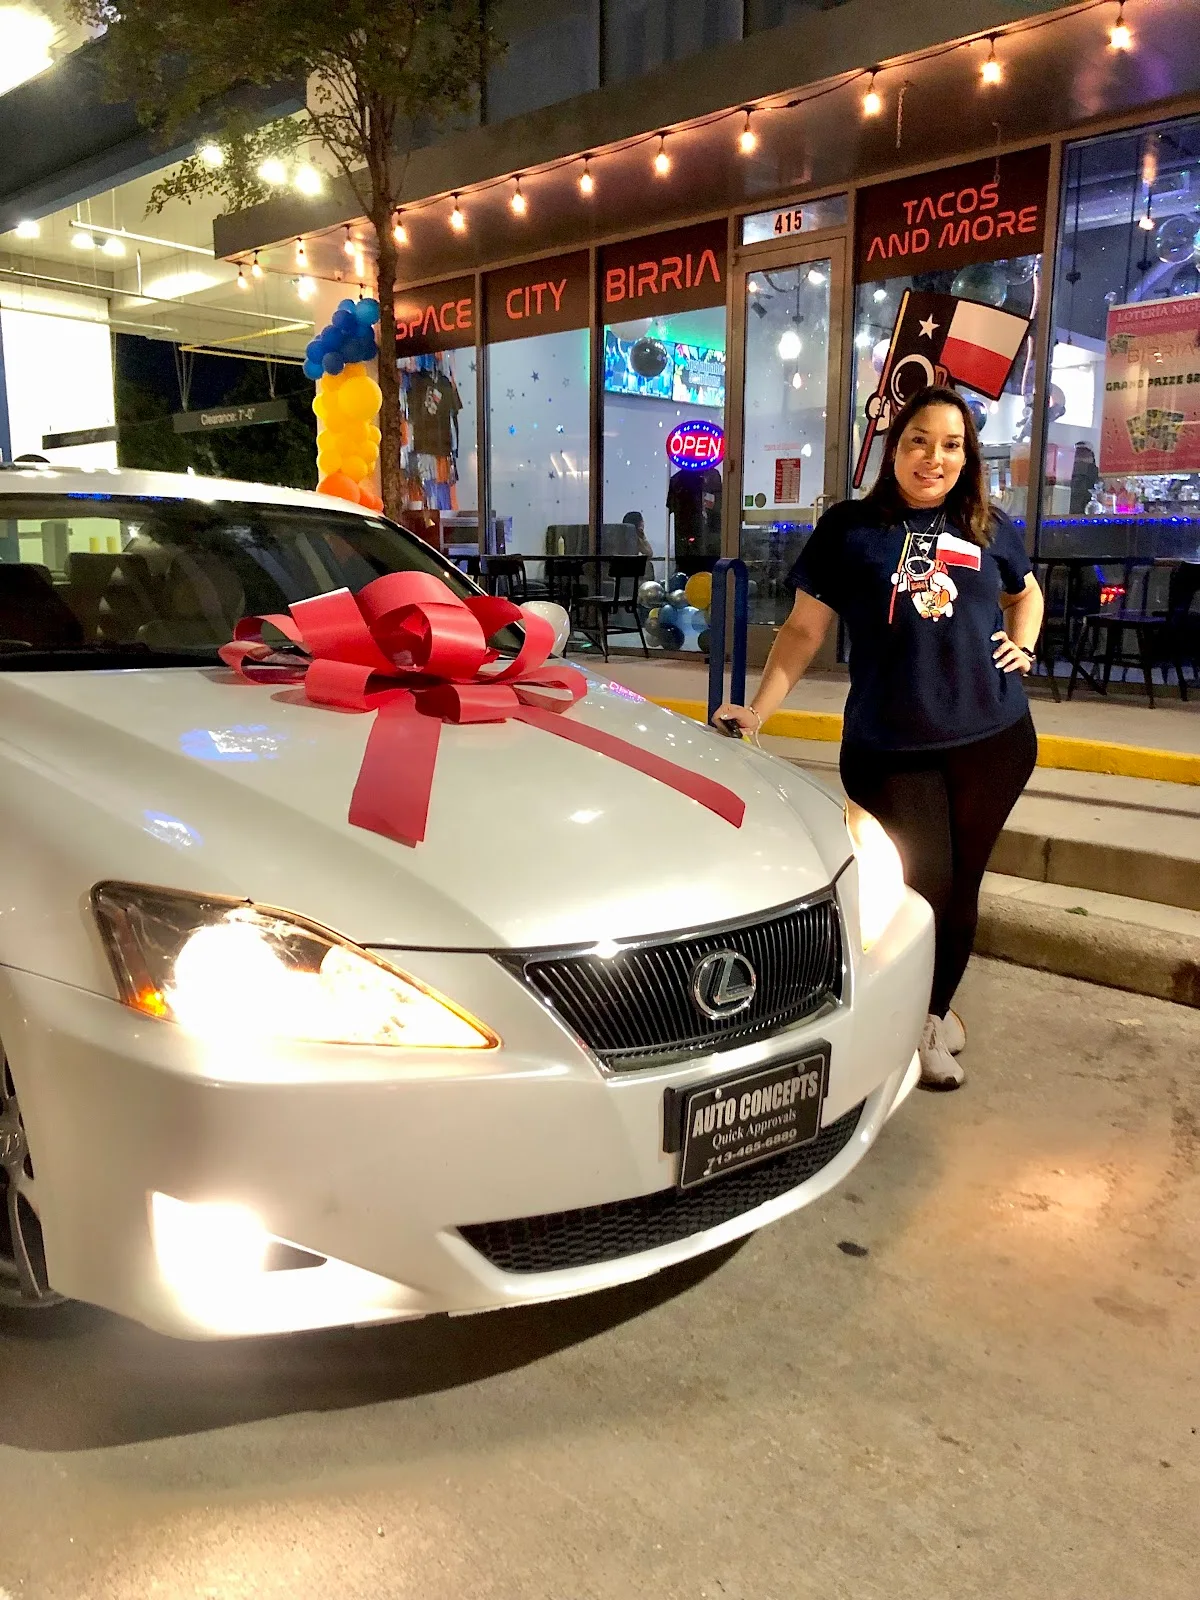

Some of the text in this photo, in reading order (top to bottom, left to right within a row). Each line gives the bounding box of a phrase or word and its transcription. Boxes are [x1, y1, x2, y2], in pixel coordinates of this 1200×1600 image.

[774, 210, 802, 234] 415
[903, 183, 999, 226] TACOS
[867, 205, 1039, 262] AND MORE
[506, 278, 567, 320] CITY
[605, 248, 721, 303] BIRRIA
[1148, 374, 1184, 388] PRIZE
[670, 434, 722, 458] OPEN
[692, 1070, 819, 1139] AUTO CONCEPTS
[712, 1108, 797, 1151] Quick Approvals
